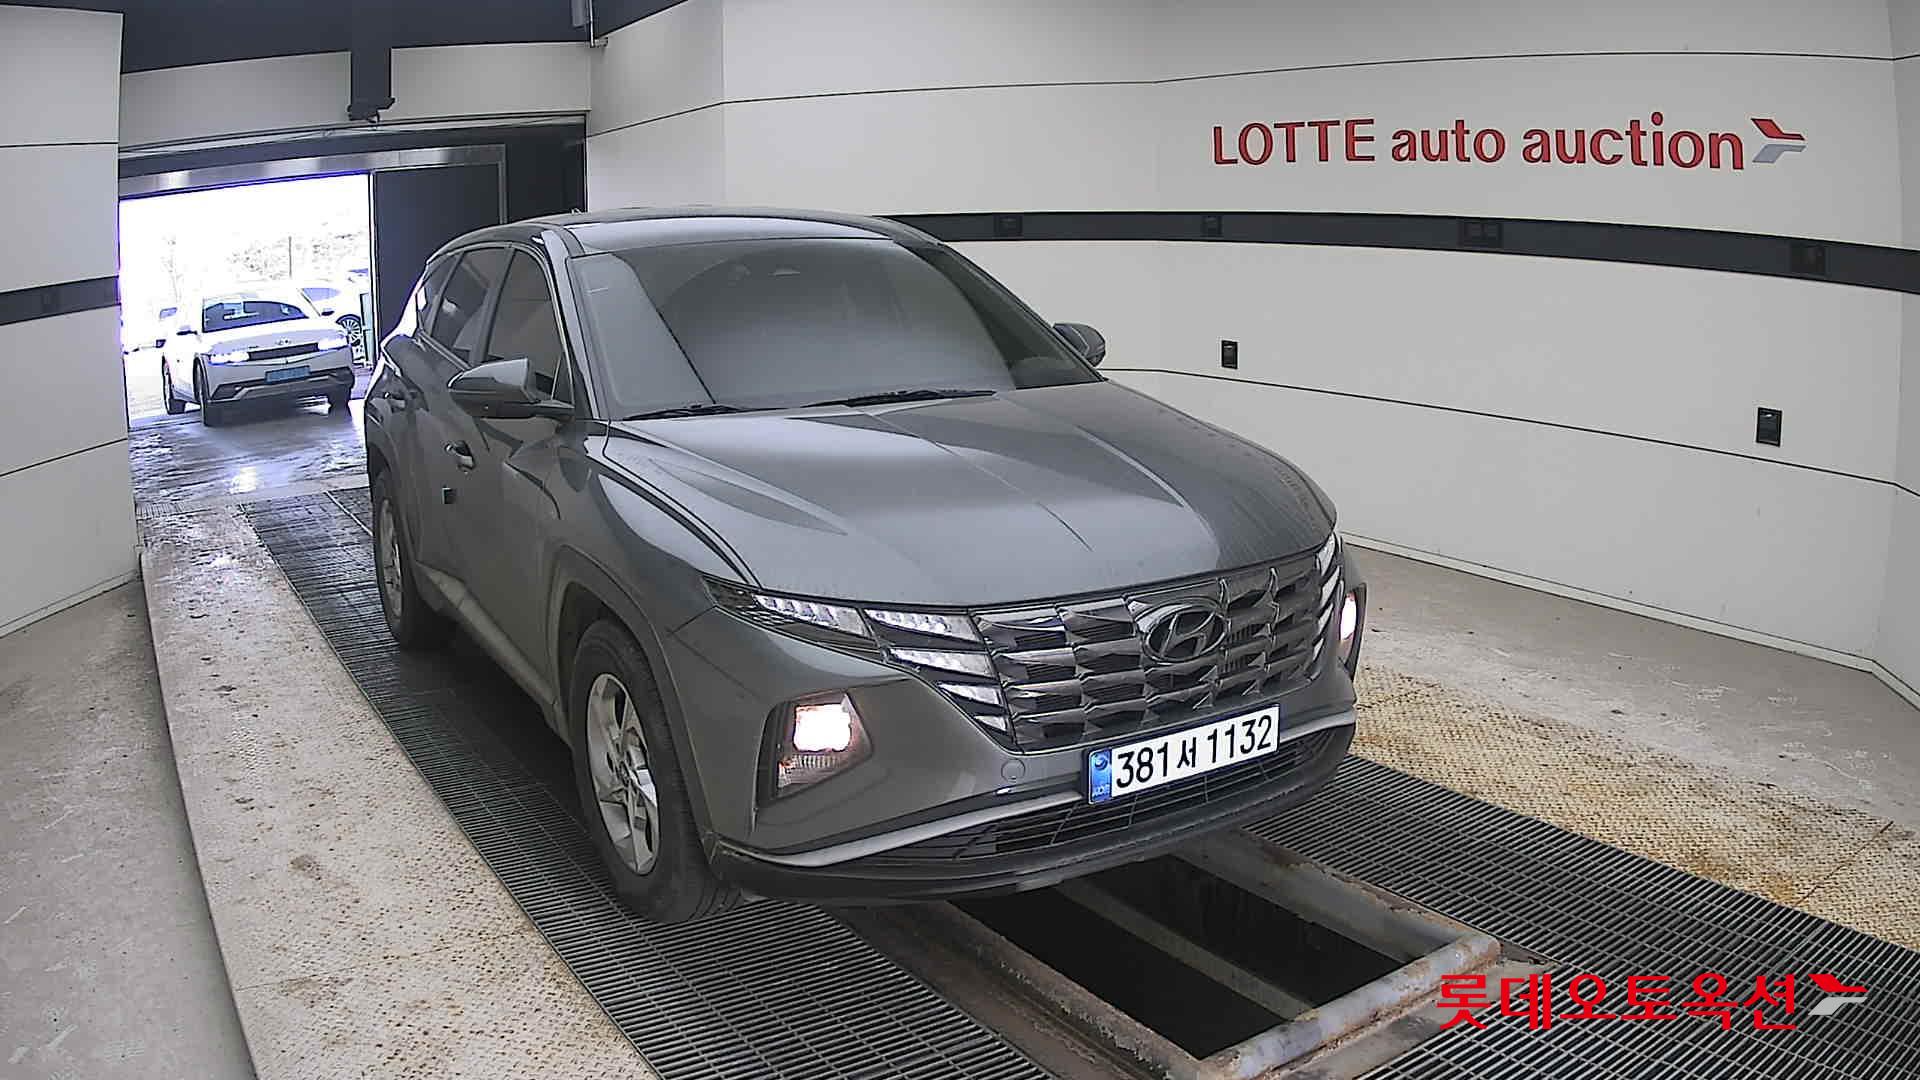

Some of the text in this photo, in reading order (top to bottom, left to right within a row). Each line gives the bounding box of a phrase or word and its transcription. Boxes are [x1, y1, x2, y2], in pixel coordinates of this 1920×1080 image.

[1213, 112, 1744, 170] LOTTE auto auction
[1207, 714, 1272, 764] 1132
